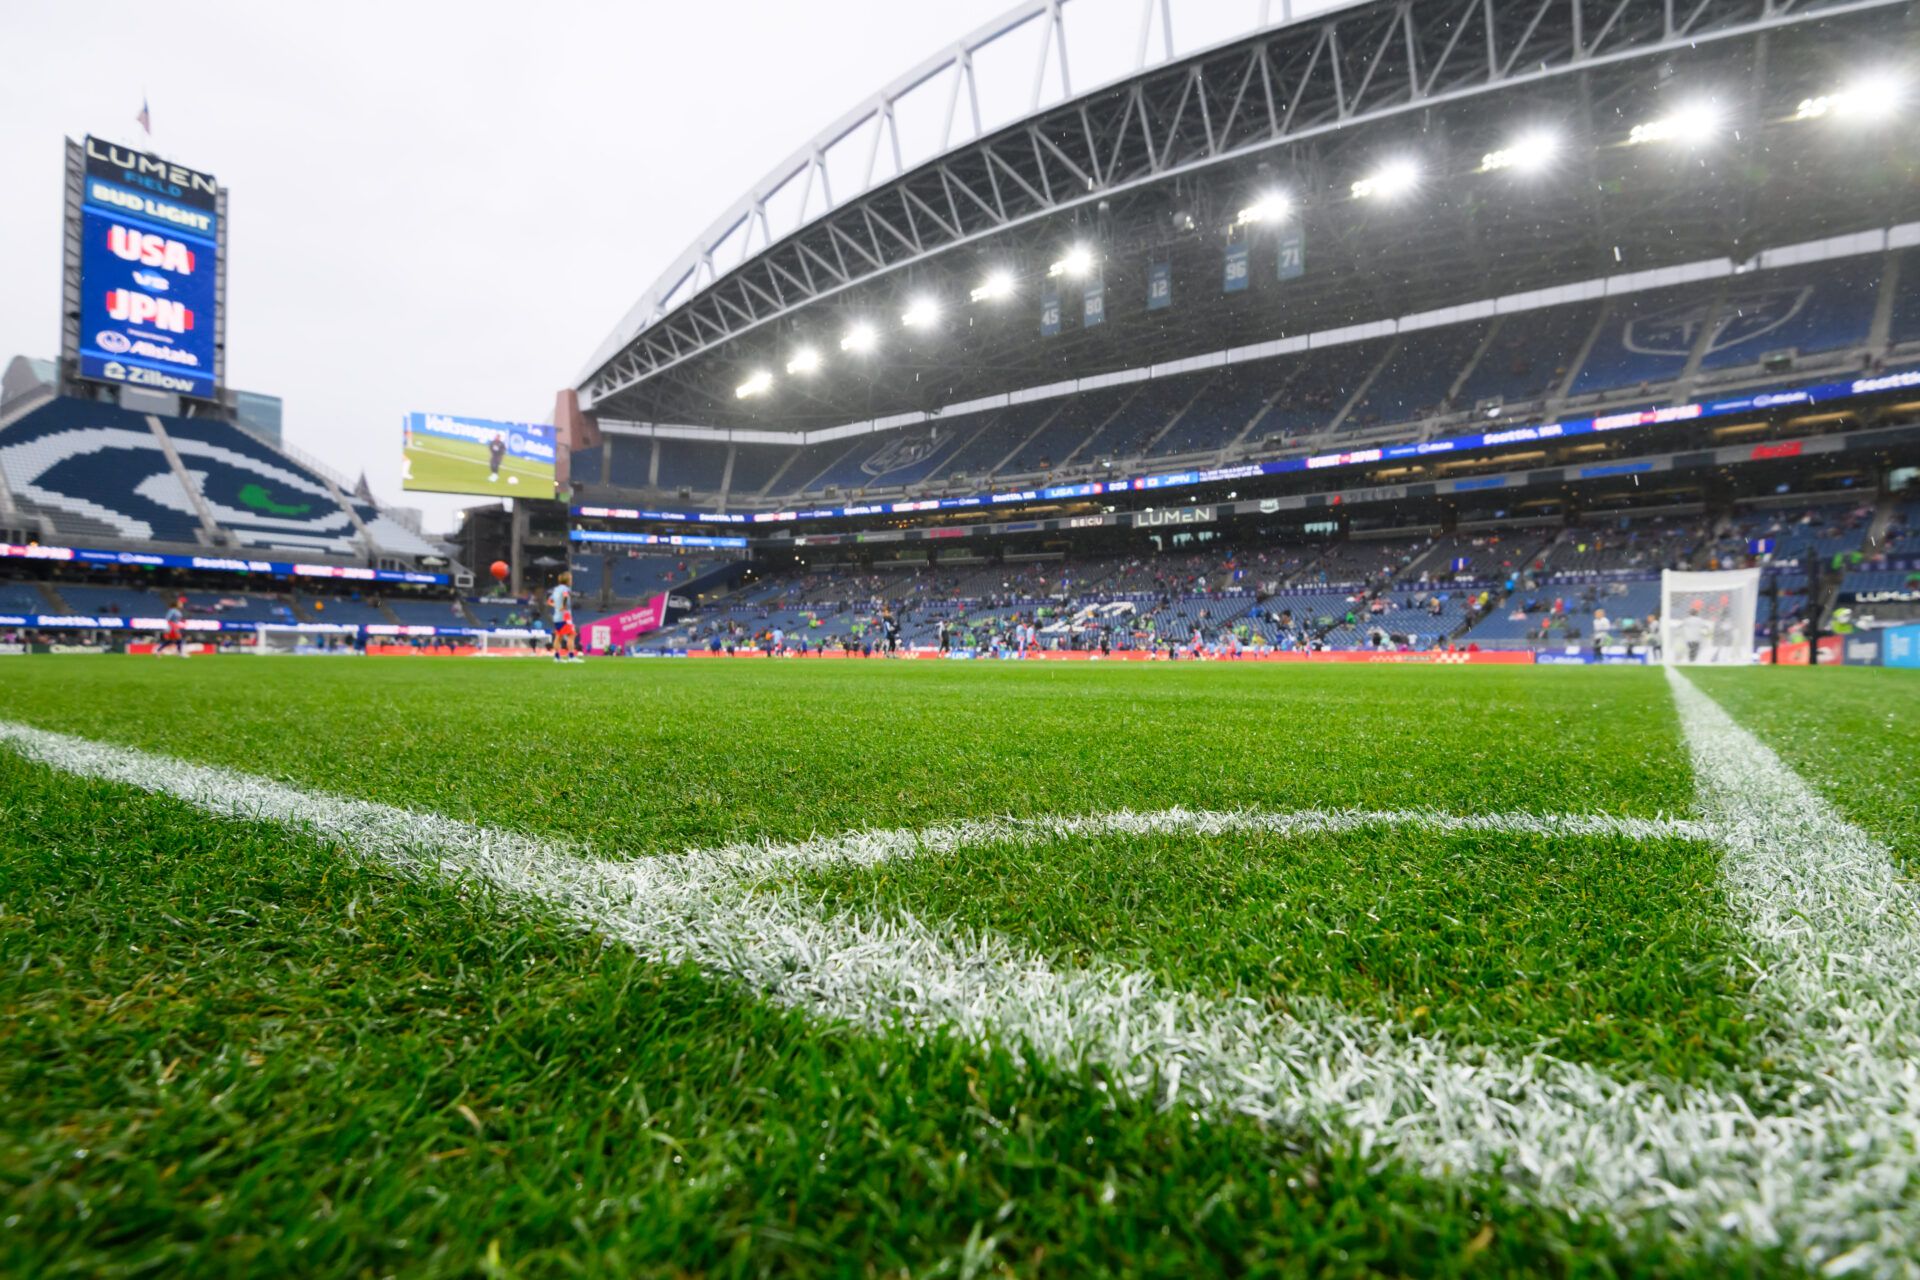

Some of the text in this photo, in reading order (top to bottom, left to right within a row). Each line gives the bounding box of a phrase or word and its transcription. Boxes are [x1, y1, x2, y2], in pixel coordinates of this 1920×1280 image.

[86, 138, 216, 195] LUMEN
[123, 171, 182, 197] FIELD
[92, 183, 211, 230] BUD LIGHT
[111, 224, 191, 275] USA
[1282, 249, 1299, 268] 71
[1226, 261, 1246, 280] 96
[1151, 280, 1168, 298] 12
[109, 288, 185, 334] JPN
[1042, 309, 1059, 326] 45
[1085, 298, 1102, 315] 80
[128, 366, 195, 392] Zillow
[1137, 507, 1210, 527] LUMEN
